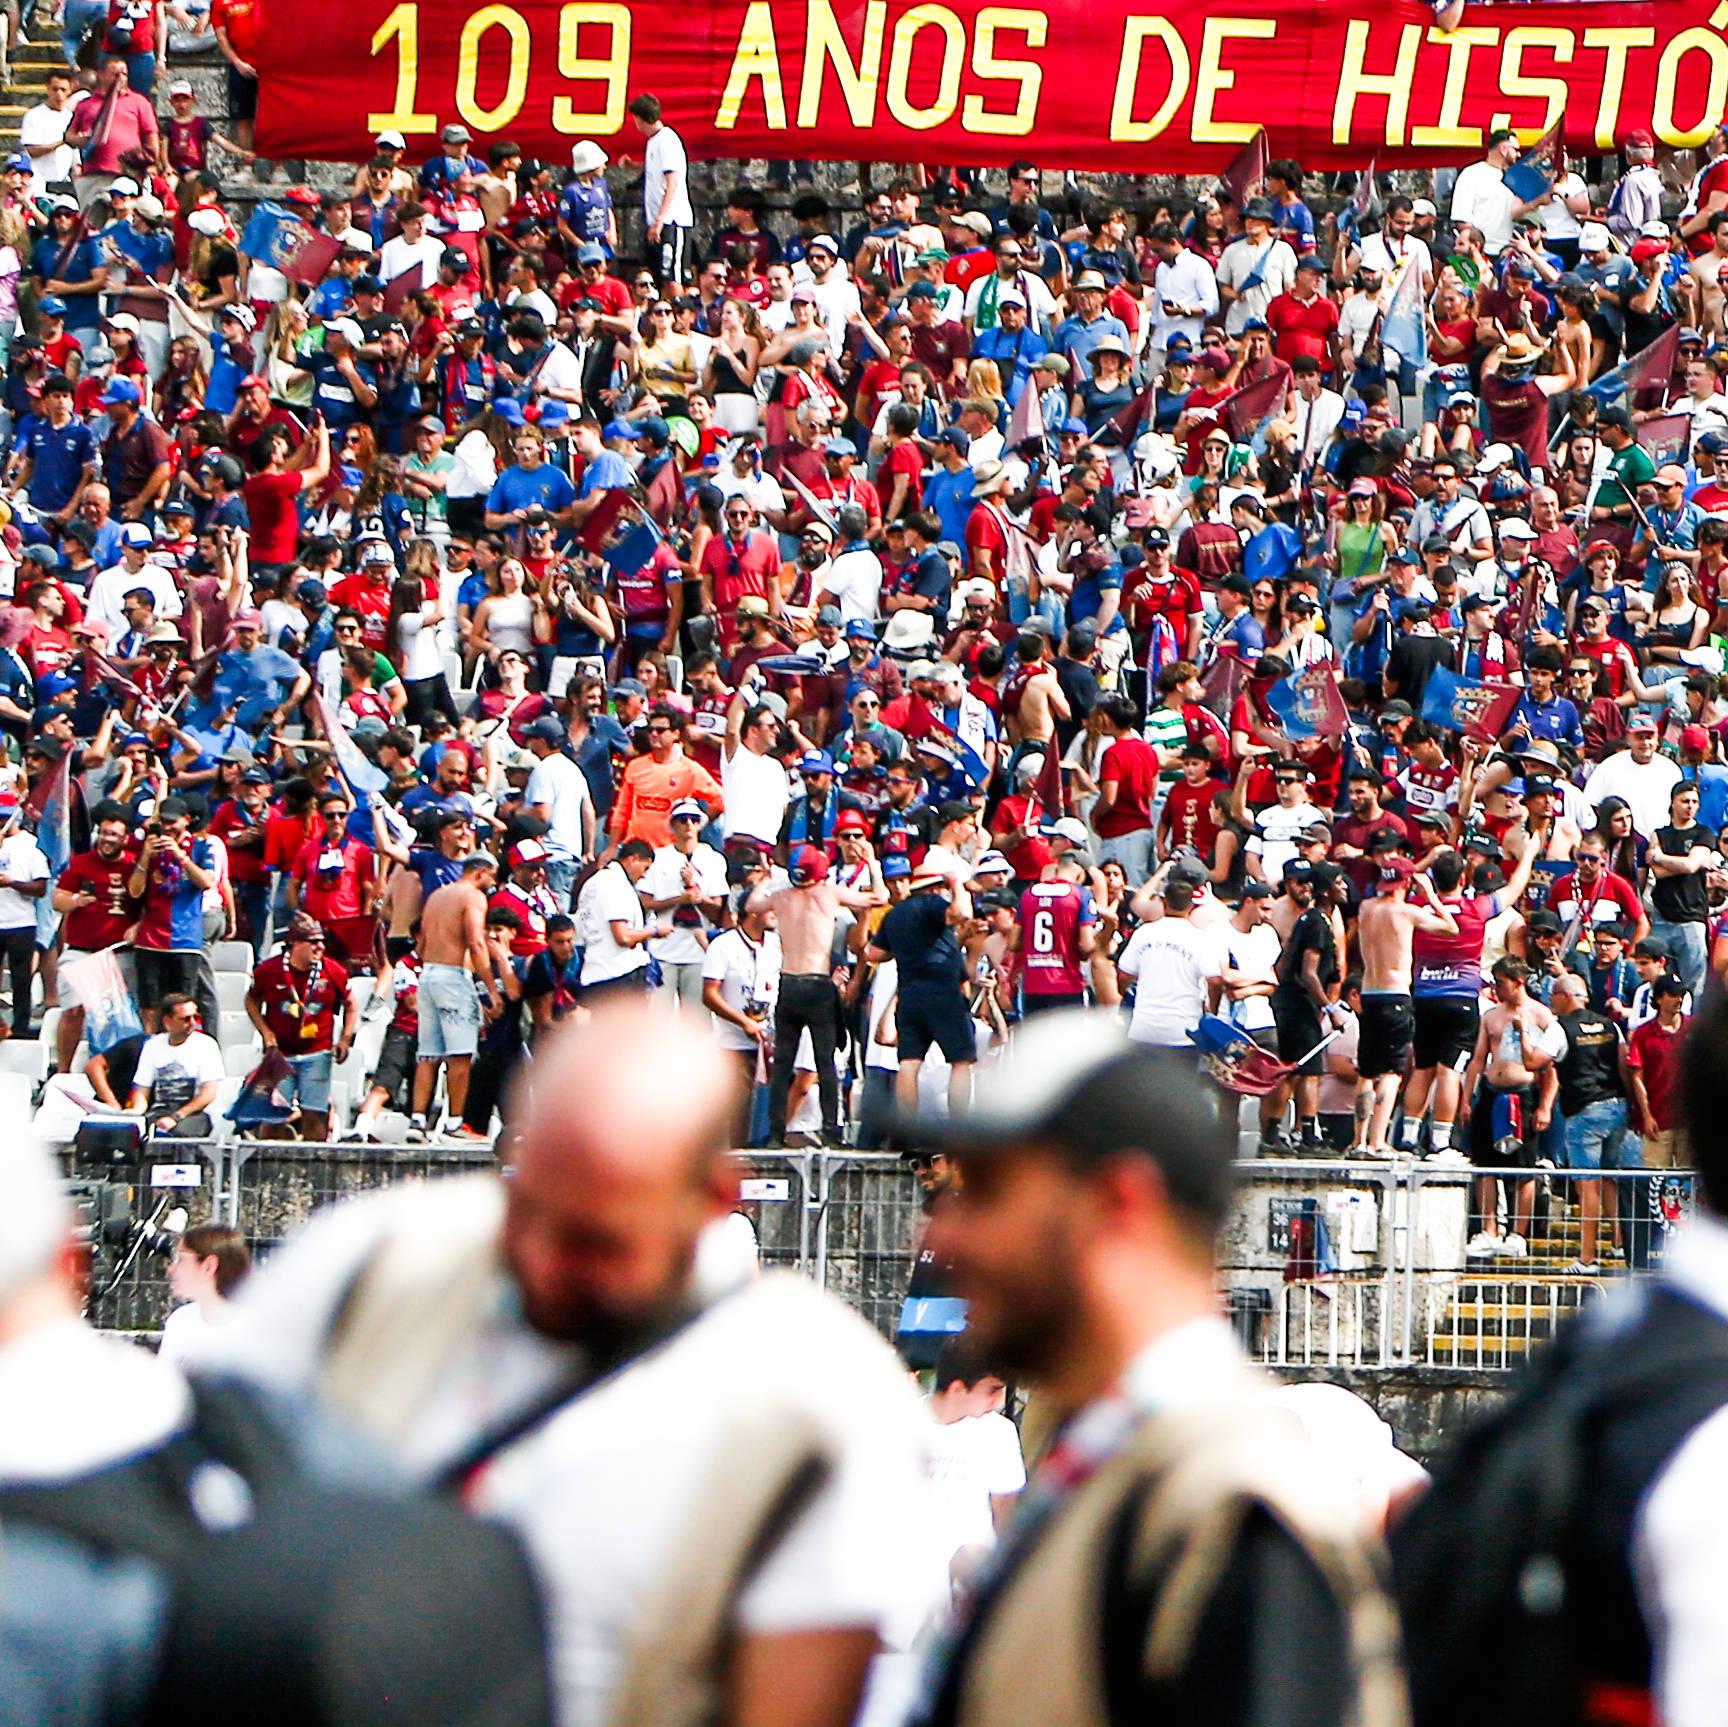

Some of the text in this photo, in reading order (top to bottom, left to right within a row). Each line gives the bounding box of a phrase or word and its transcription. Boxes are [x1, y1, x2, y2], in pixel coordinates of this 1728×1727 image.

[368, 2, 632, 135] 109
[1110, 15, 1277, 142] DE
[1033, 911, 1053, 954] 6
[1273, 1212, 1289, 1227] 36
[1272, 1233, 1289, 1248] 14
